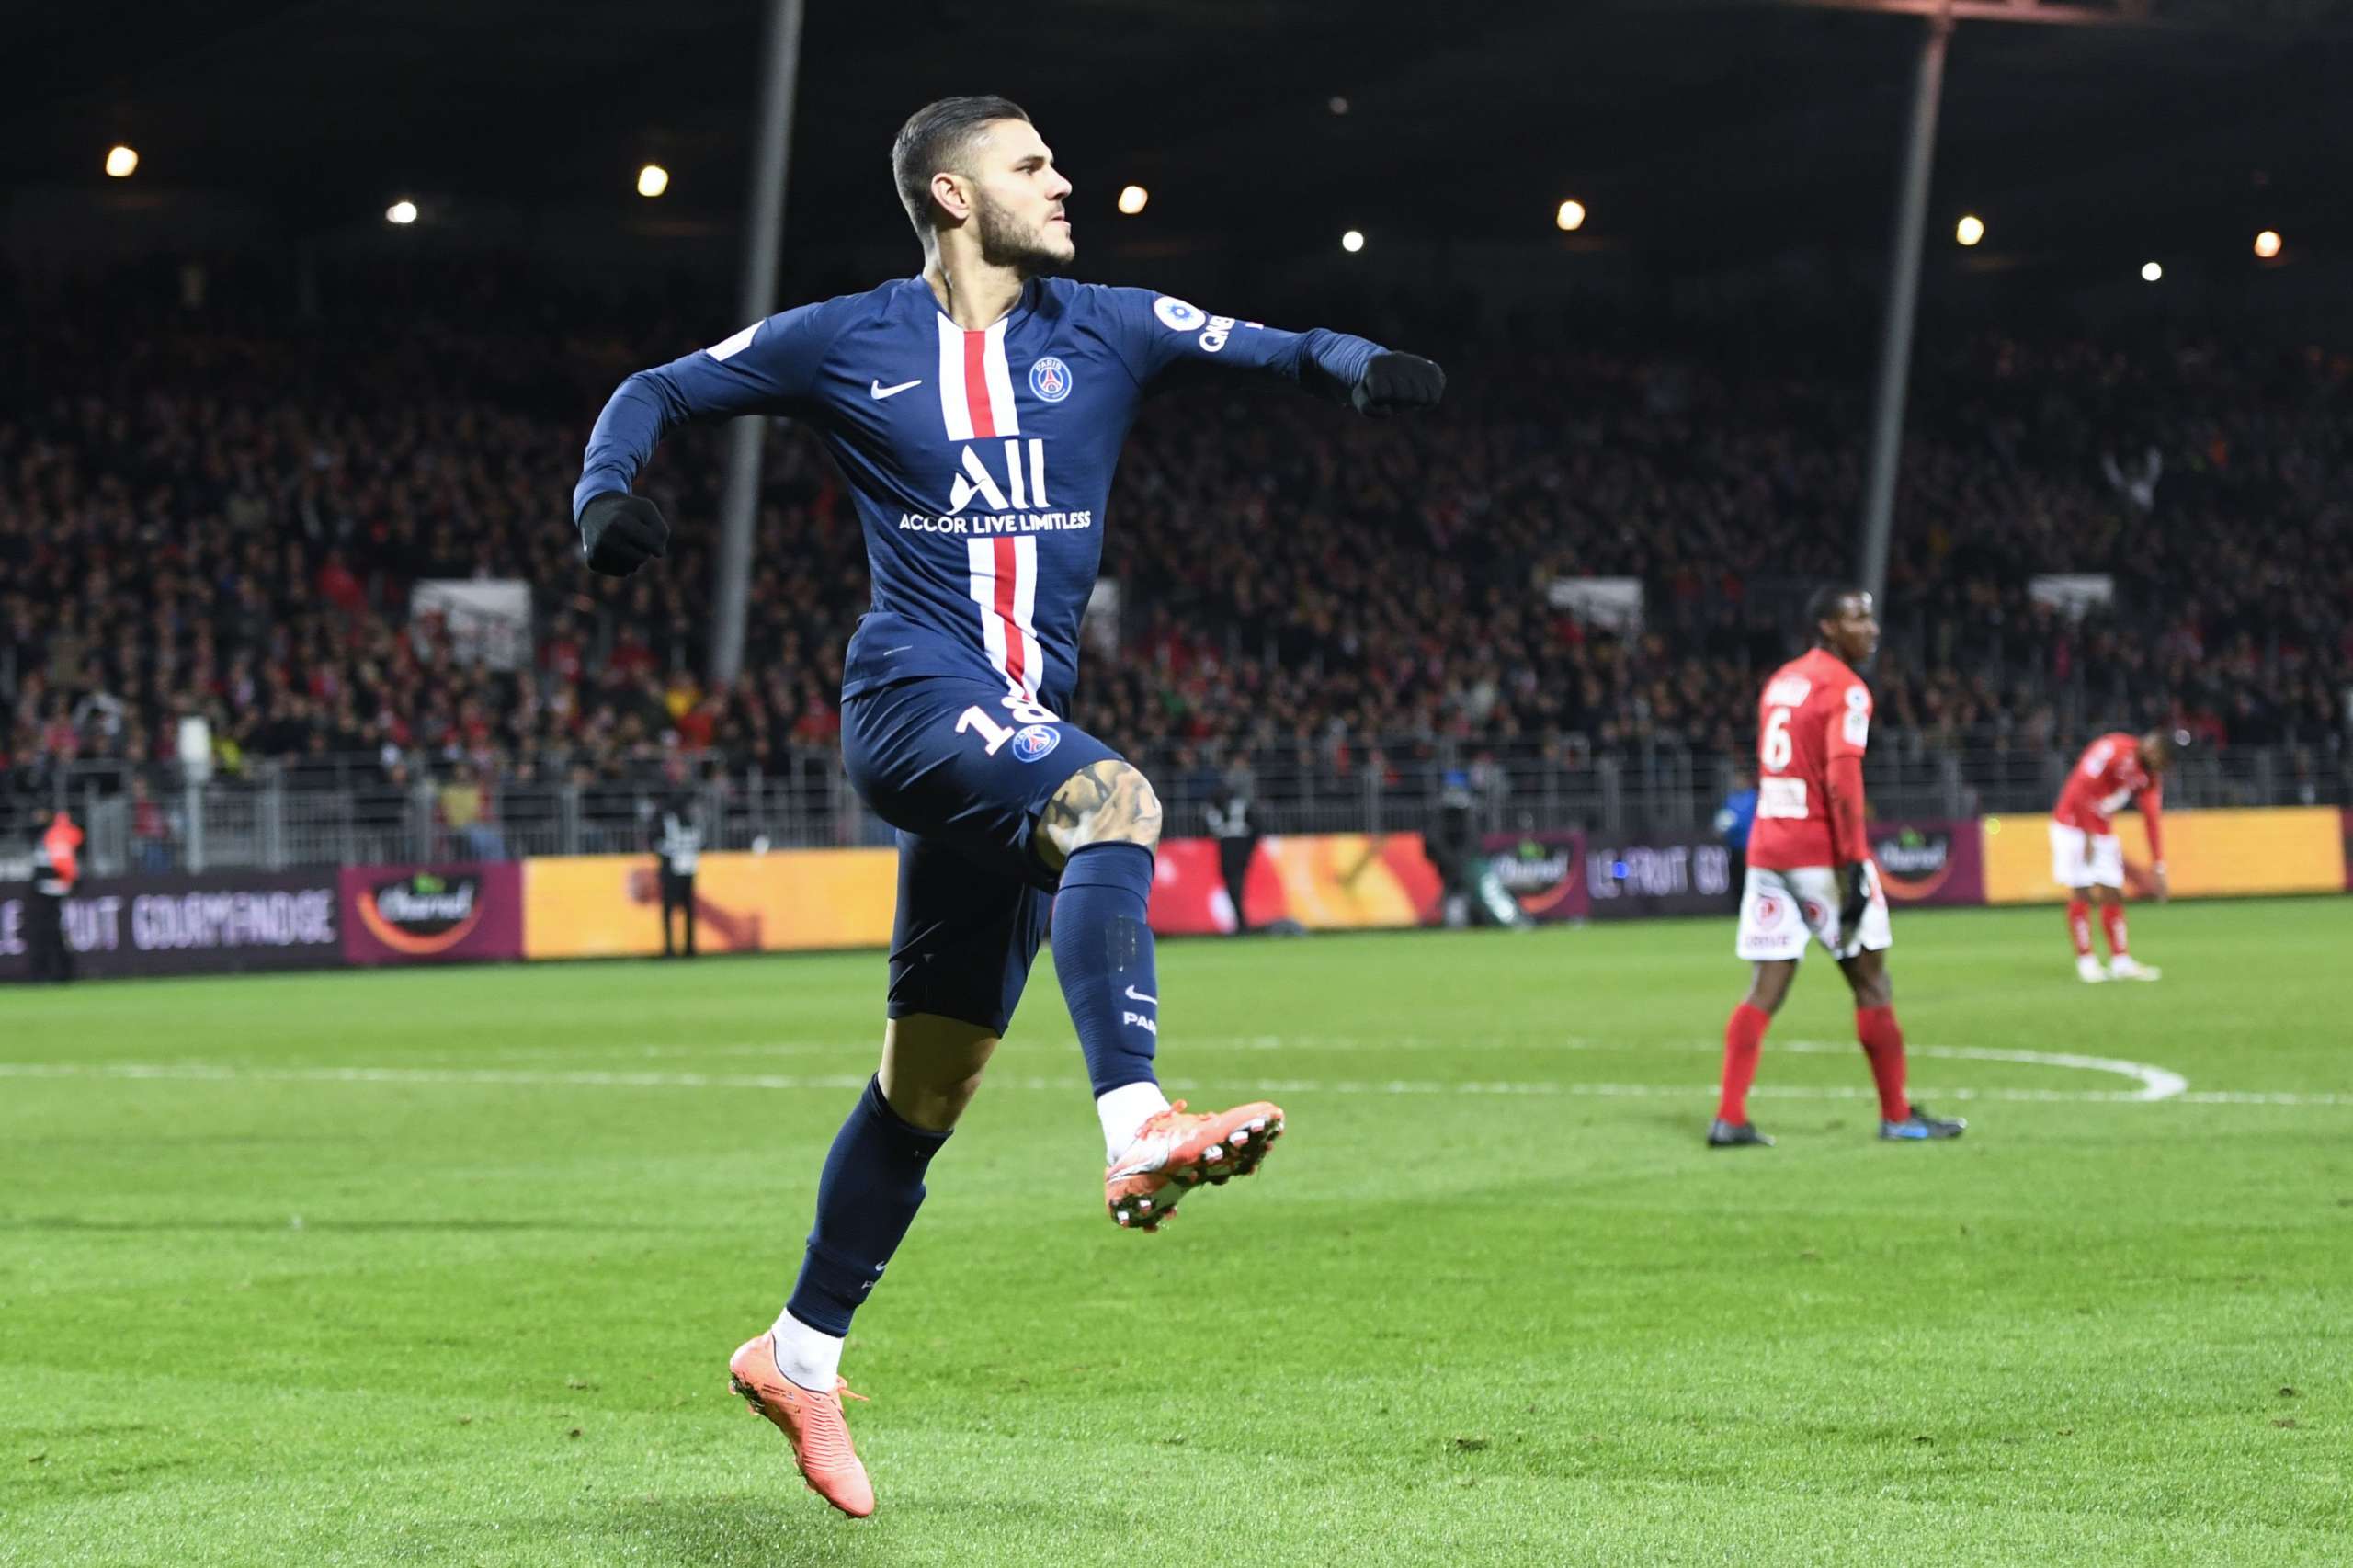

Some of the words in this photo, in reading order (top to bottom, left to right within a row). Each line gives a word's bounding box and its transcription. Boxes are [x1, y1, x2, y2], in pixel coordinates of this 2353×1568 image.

[1035, 359, 1062, 372] PARIS
[899, 514, 968, 533] ACCOR
[972, 515, 1017, 533] LIVE
[1019, 511, 1091, 531] LIMITLESS
[1761, 706, 1792, 772] 6
